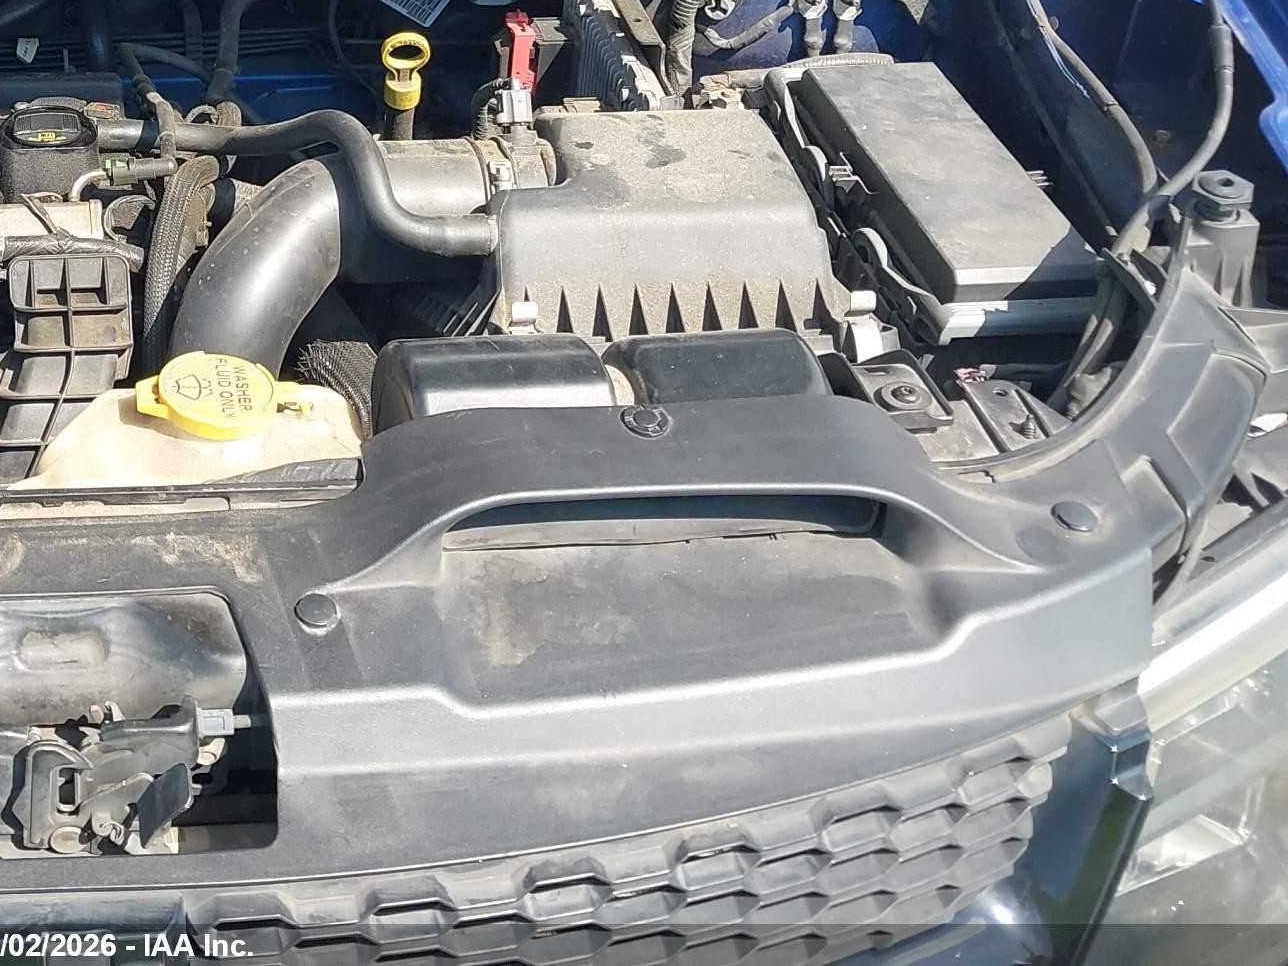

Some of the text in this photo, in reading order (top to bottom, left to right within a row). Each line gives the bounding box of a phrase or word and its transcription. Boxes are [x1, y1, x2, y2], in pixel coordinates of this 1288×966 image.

[215, 358, 236, 419] FLUID ONLY
[233, 365, 253, 412] WASHER
